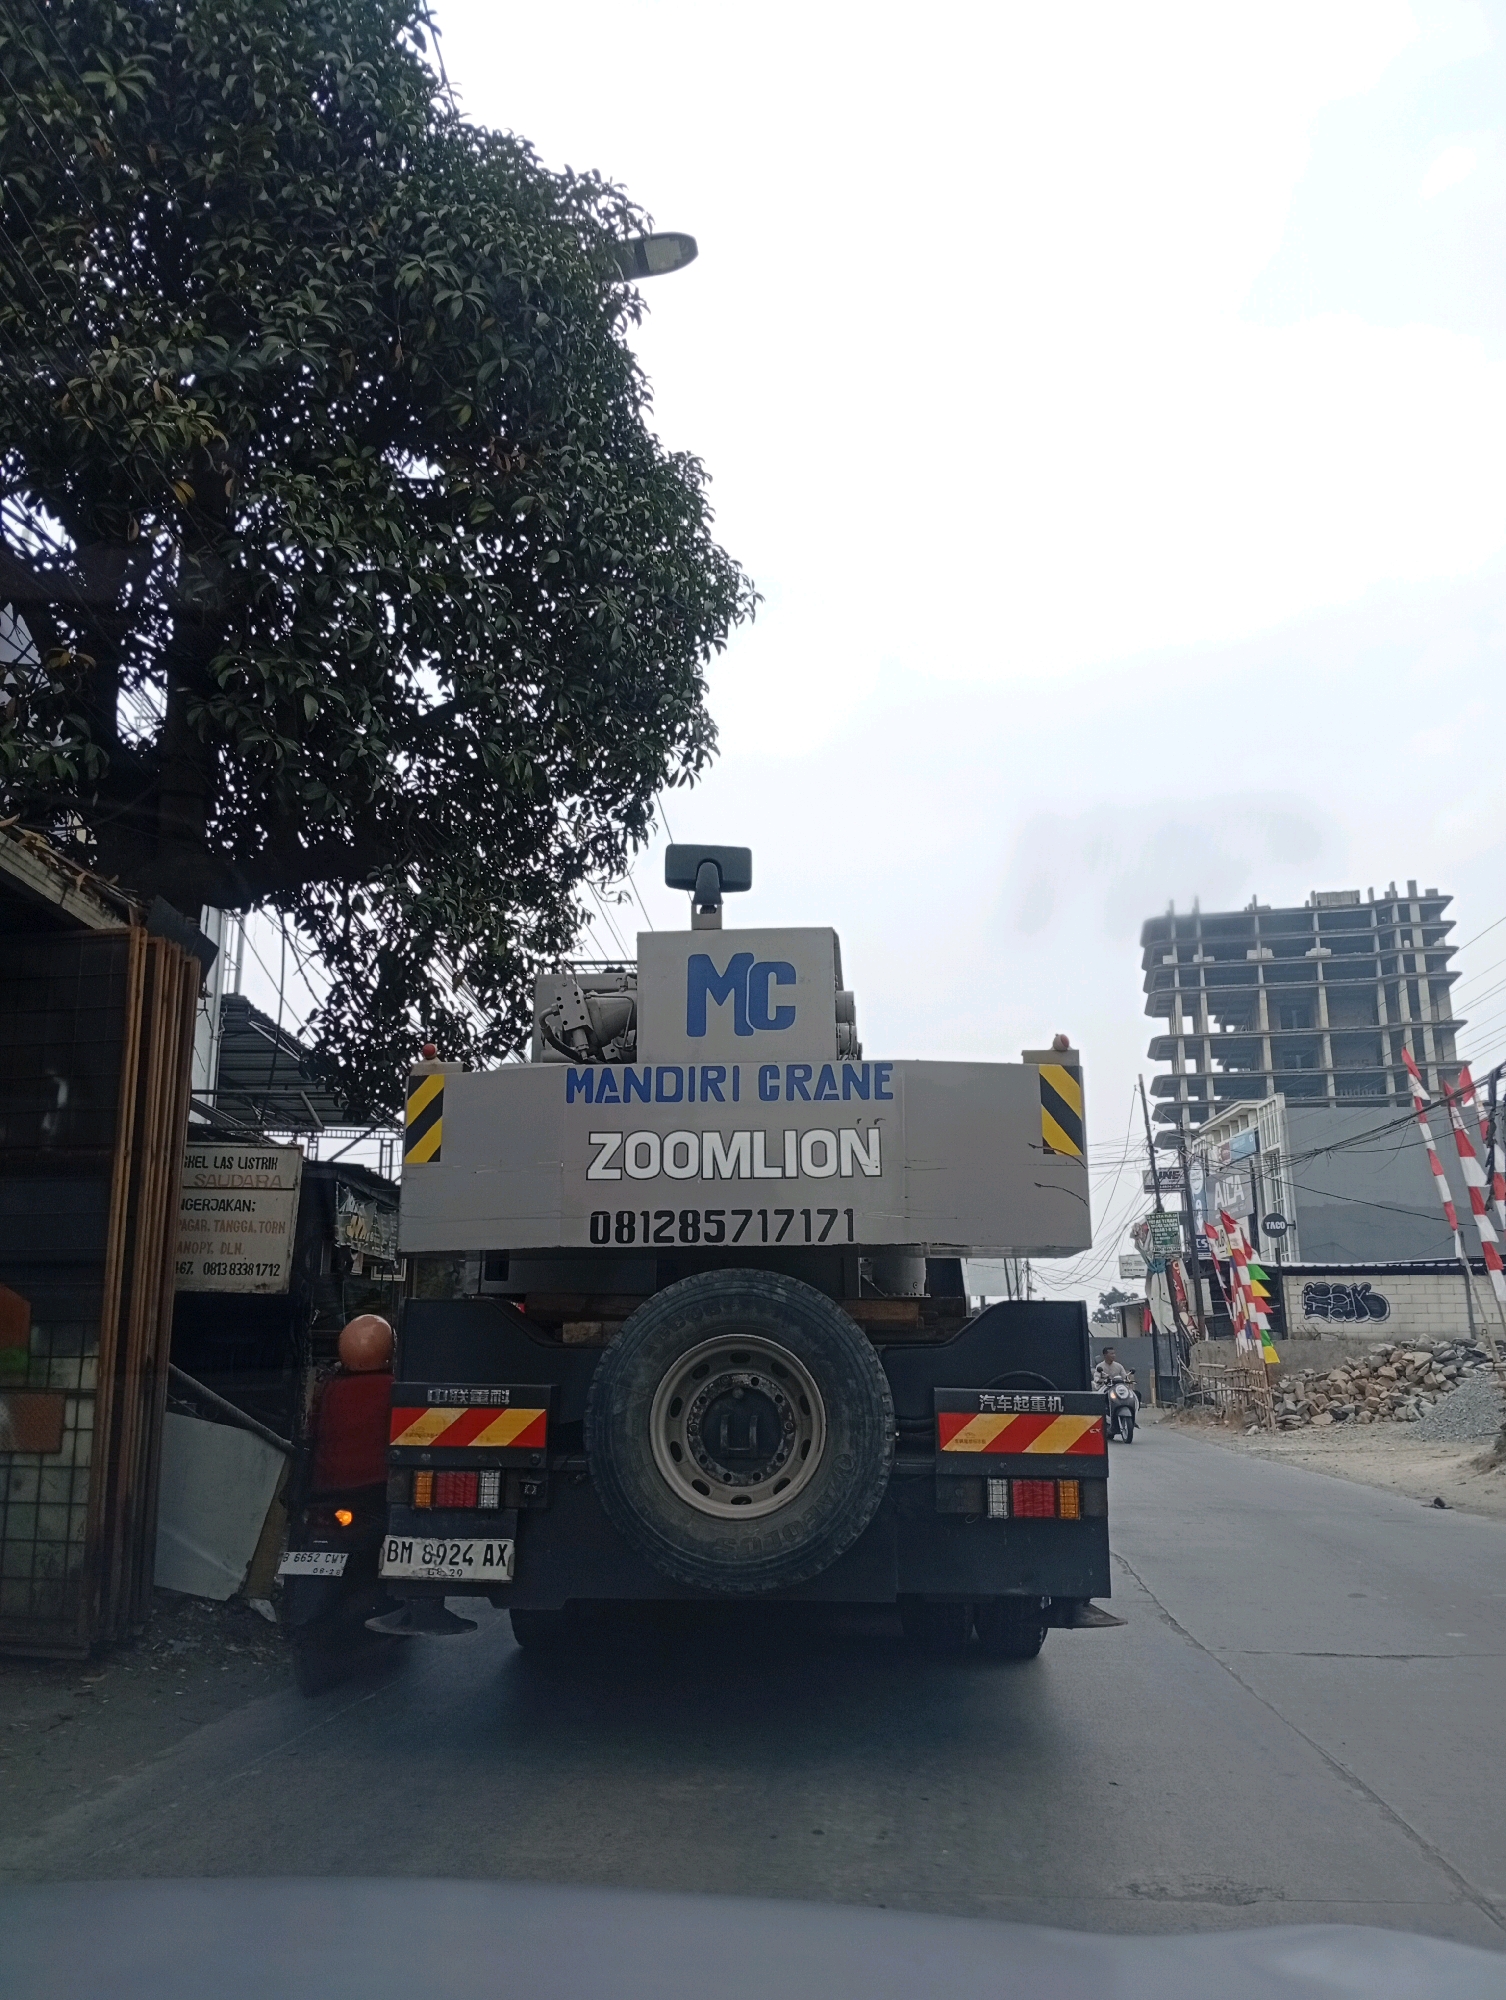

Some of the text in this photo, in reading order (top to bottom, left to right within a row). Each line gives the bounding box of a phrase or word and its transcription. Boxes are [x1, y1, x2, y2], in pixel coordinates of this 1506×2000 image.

[686, 952, 797, 1038] MC
[566, 1063, 894, 1103] MANDIRI CRANE
[213, 1156, 234, 1170] LAS
[237, 1156, 279, 1171] LISTRIK
[586, 1128, 882, 1181] ZOOMLION
[193, 1173, 283, 1188] SAUDARA
[589, 1208, 855, 1244] 081285717171
[1265, 1221, 1286, 1230] TACO
[979, 1394, 1065, 1413] 汽车起重机
[386, 1539, 509, 1568] BM 8924 AX
